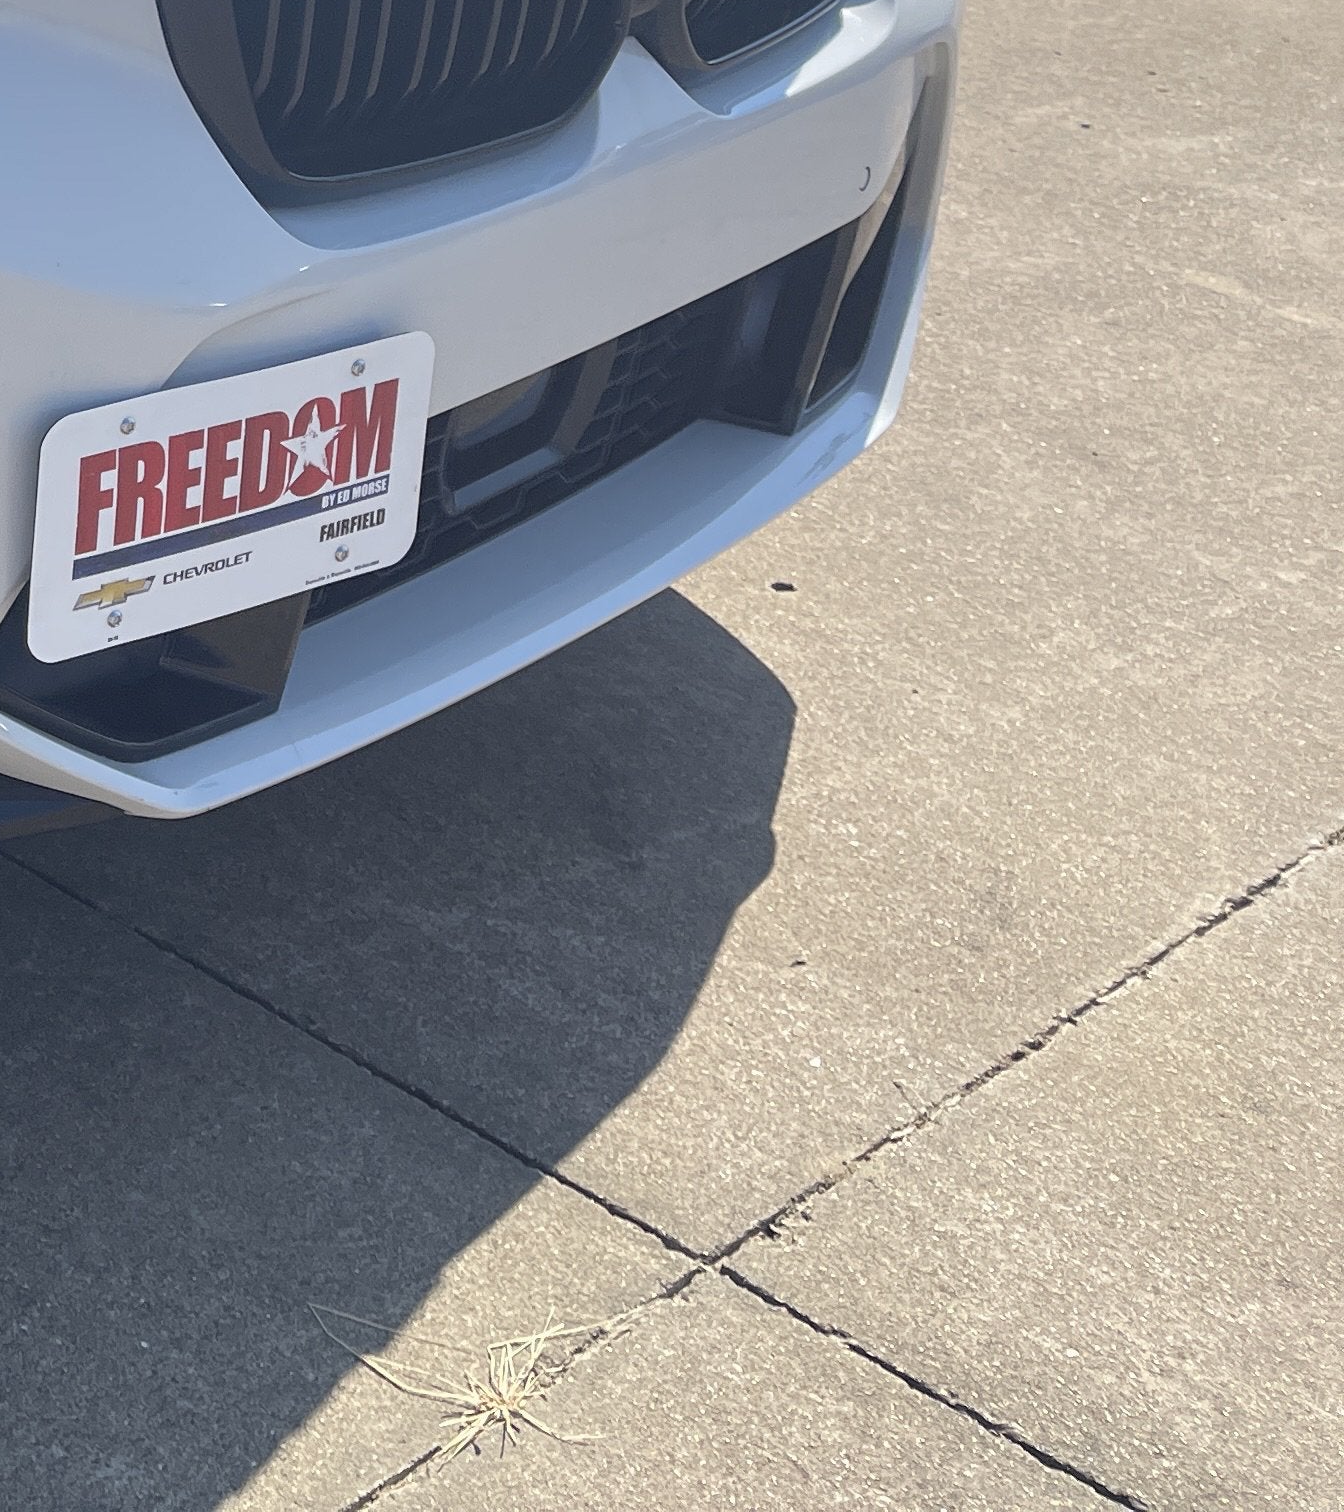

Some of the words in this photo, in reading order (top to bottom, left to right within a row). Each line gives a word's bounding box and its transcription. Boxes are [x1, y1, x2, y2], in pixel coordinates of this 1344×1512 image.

[74, 378, 400, 556] FREEDOM
[321, 493, 336, 509] BY
[336, 489, 351, 505] ED
[352, 477, 388, 501] MORSE
[319, 508, 386, 543] FAIRFIELD
[163, 551, 253, 585] CHEVROLET
